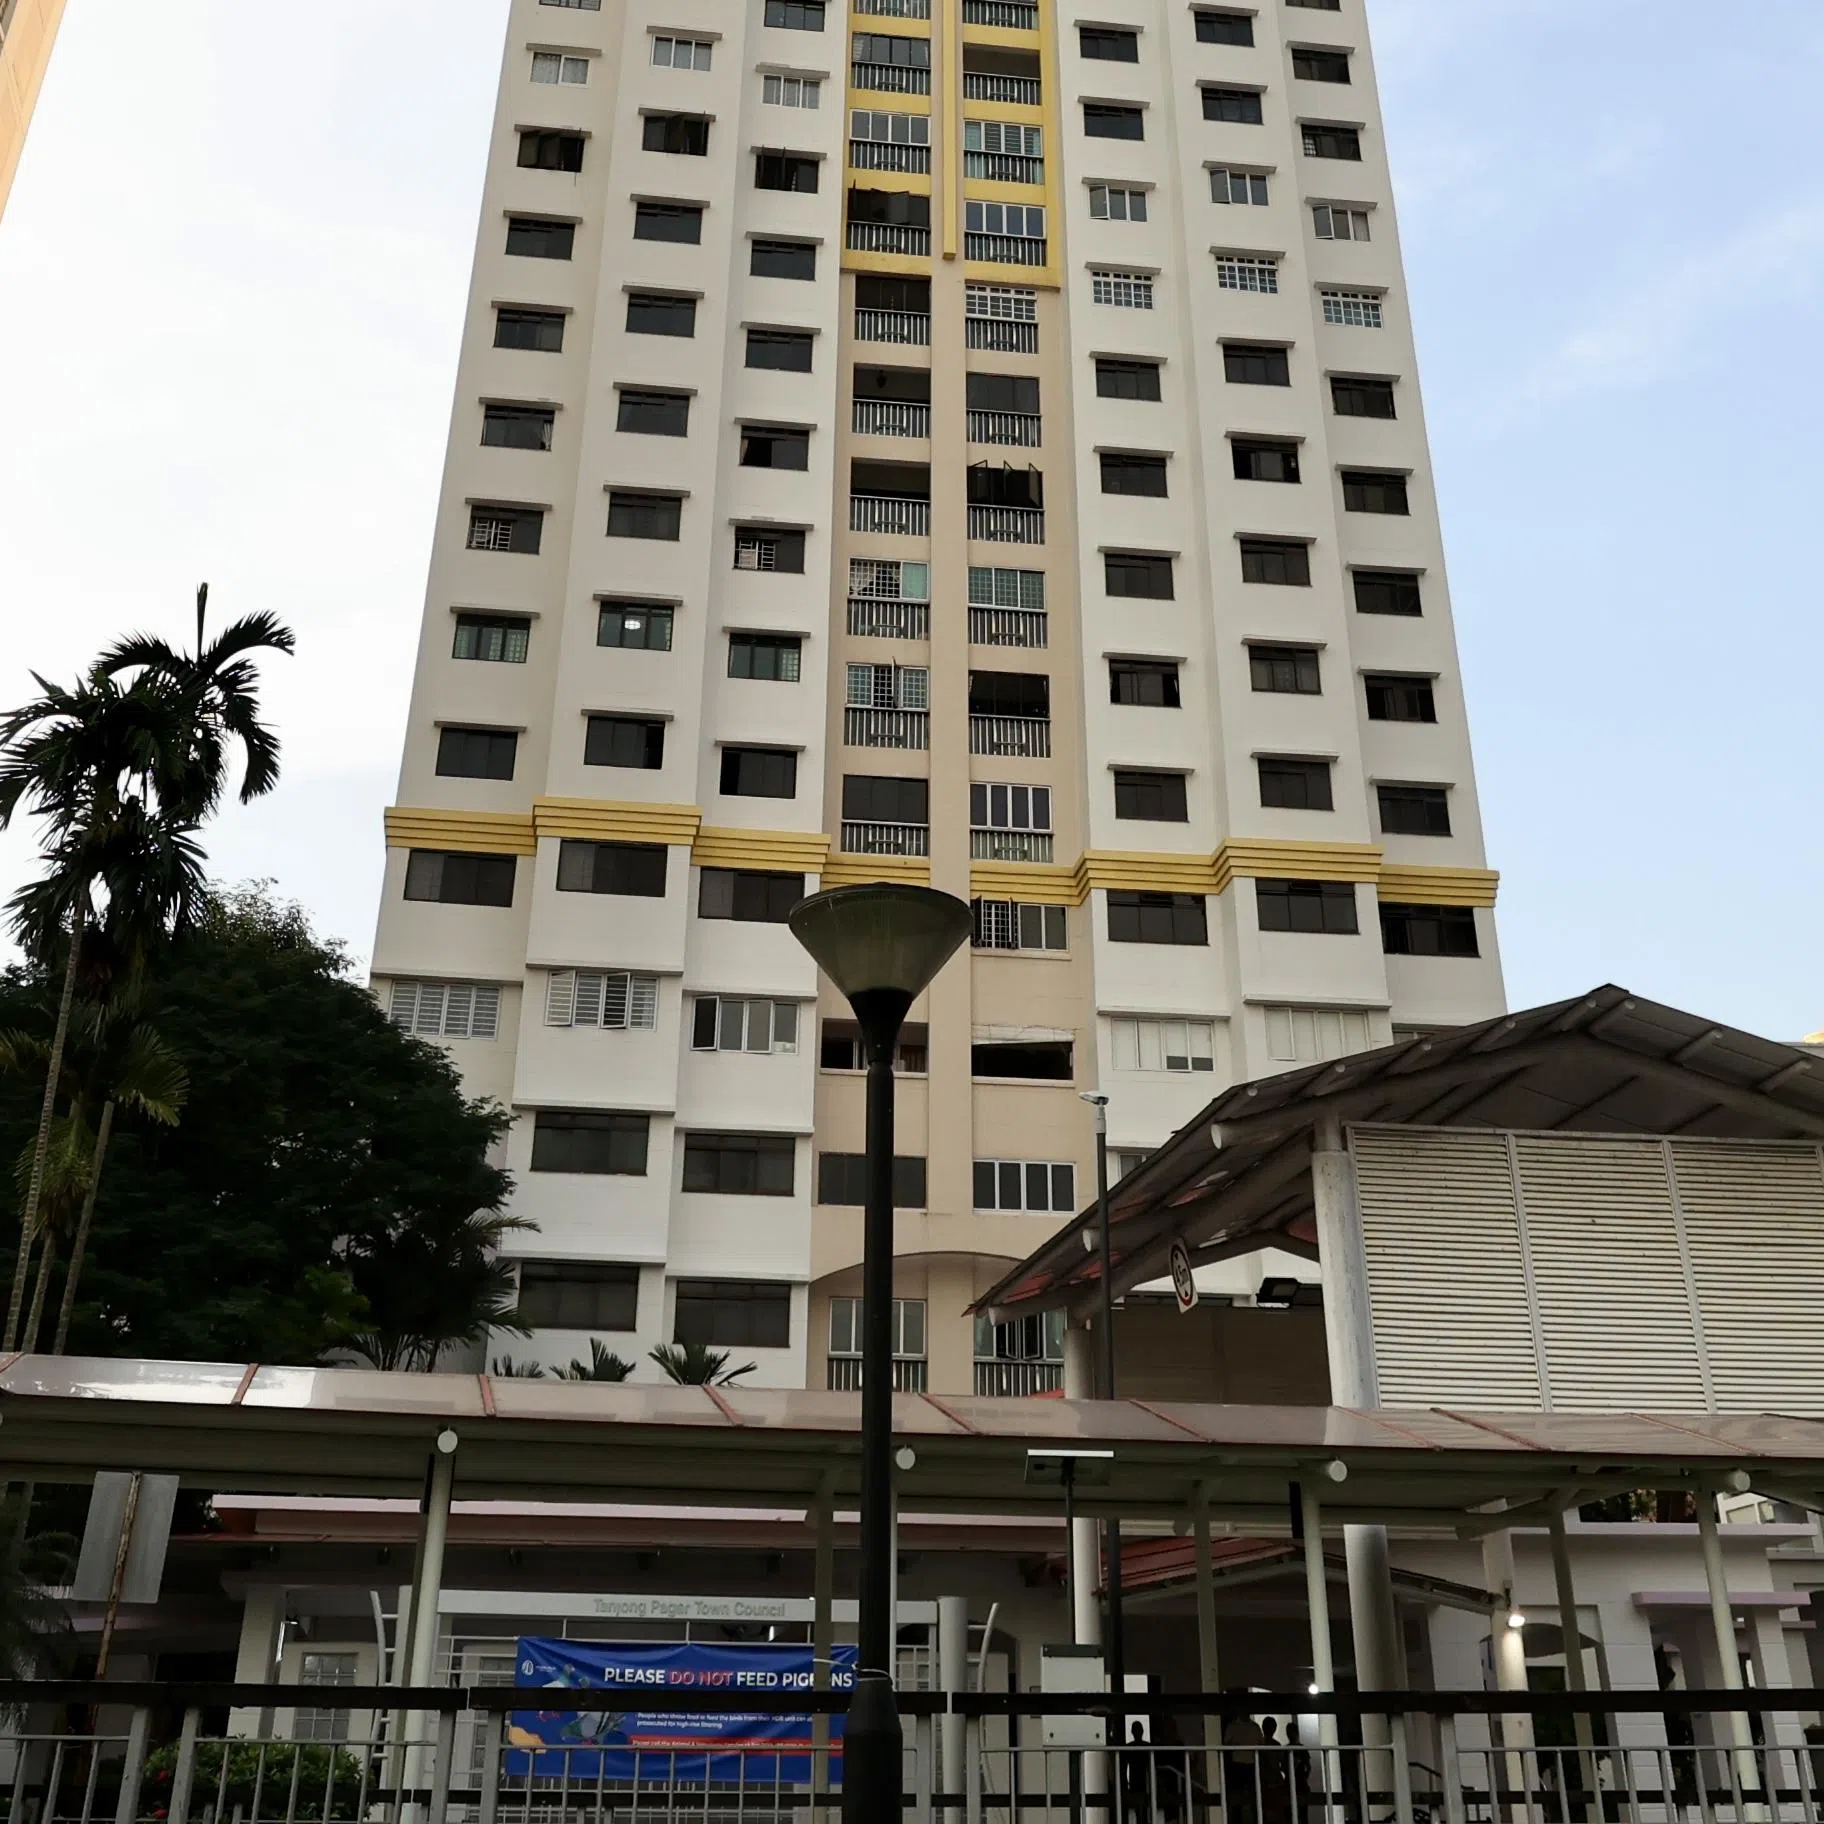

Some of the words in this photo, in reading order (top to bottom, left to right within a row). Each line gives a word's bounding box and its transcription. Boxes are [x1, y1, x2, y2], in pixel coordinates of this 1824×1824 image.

[593, 1598, 646, 1617] Tanjong
[650, 1600, 690, 1618] Pagar
[694, 1600, 729, 1616] Town
[734, 1602, 786, 1617] Council
[604, 1667, 666, 1684] PLEASE
[670, 1671, 695, 1685] DO
[699, 1671, 734, 1687] NOT
[736, 1671, 778, 1687] FEED
[782, 1672, 853, 1688] PIGNS
